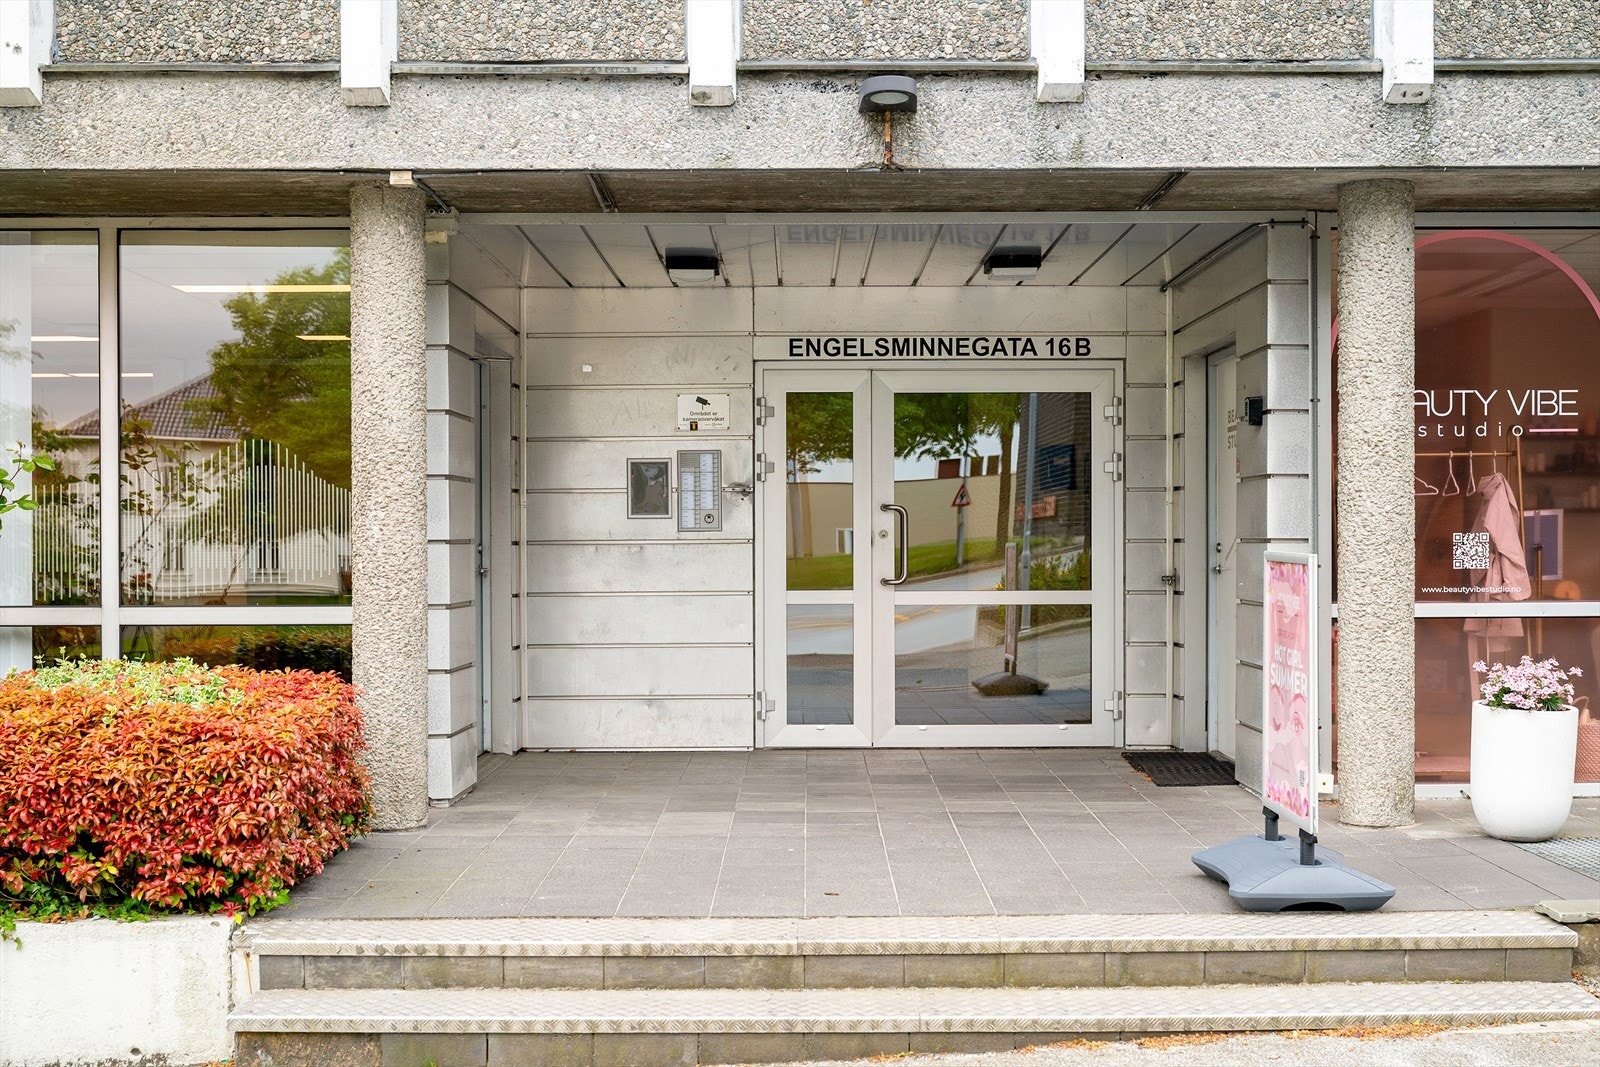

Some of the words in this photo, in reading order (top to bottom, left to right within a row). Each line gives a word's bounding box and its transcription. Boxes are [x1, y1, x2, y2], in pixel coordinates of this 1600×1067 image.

[788, 337, 1038, 357] ENGELSMINNEGATA
[1045, 337, 1092, 357] 16B
[1507, 389, 1579, 416] VIBE
[1418, 422, 1524, 437] studio
[1421, 586, 1522, 594] www.beautyvibestudio.no
[1274, 643, 1286, 663] HOT
[1286, 647, 1303, 669] GIRL
[1270, 662, 1308, 698] SUMMER
